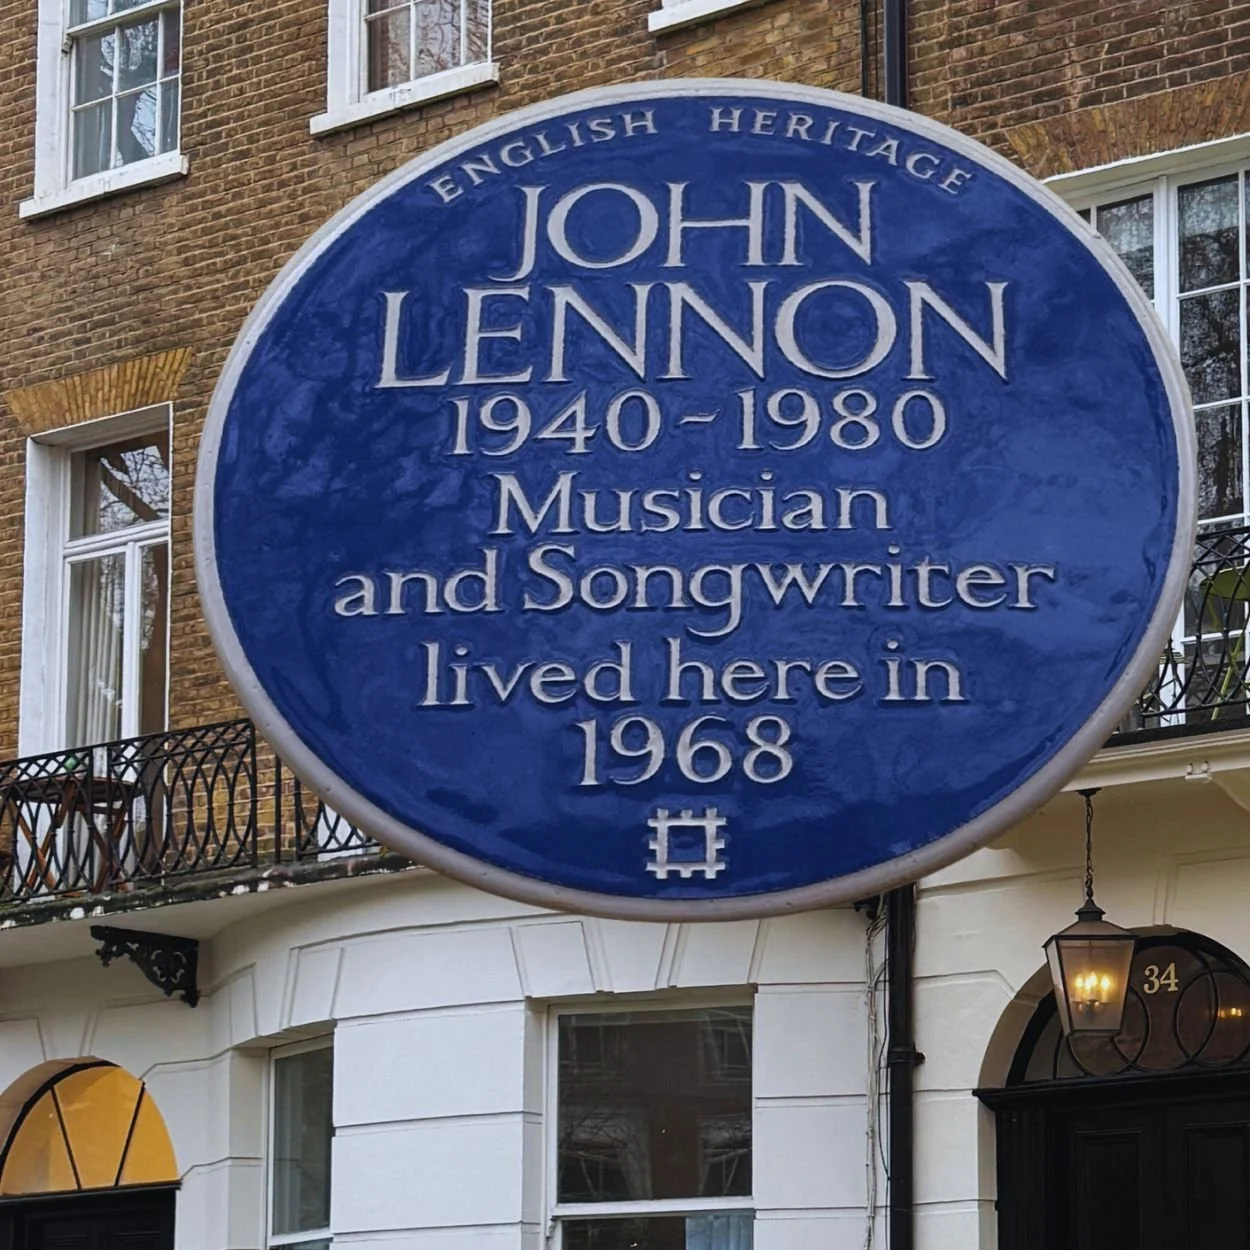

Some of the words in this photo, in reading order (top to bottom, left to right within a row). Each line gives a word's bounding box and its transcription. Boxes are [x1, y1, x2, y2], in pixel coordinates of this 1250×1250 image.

[429, 110, 658, 204] ENGLISH
[709, 106, 973, 195] HERITAGE
[491, 180, 876, 282] JOHN
[375, 279, 1010, 389] LENNON
[490, 470, 891, 535] Musician
[333, 547, 500, 617] and
[522, 542, 1056, 638] Songwriter
[416, 640, 636, 708] lived
[663, 636, 860, 702] here
[883, 640, 966, 702] in
[576, 714, 794, 787] 1968
[1143, 962, 1179, 994] 34
